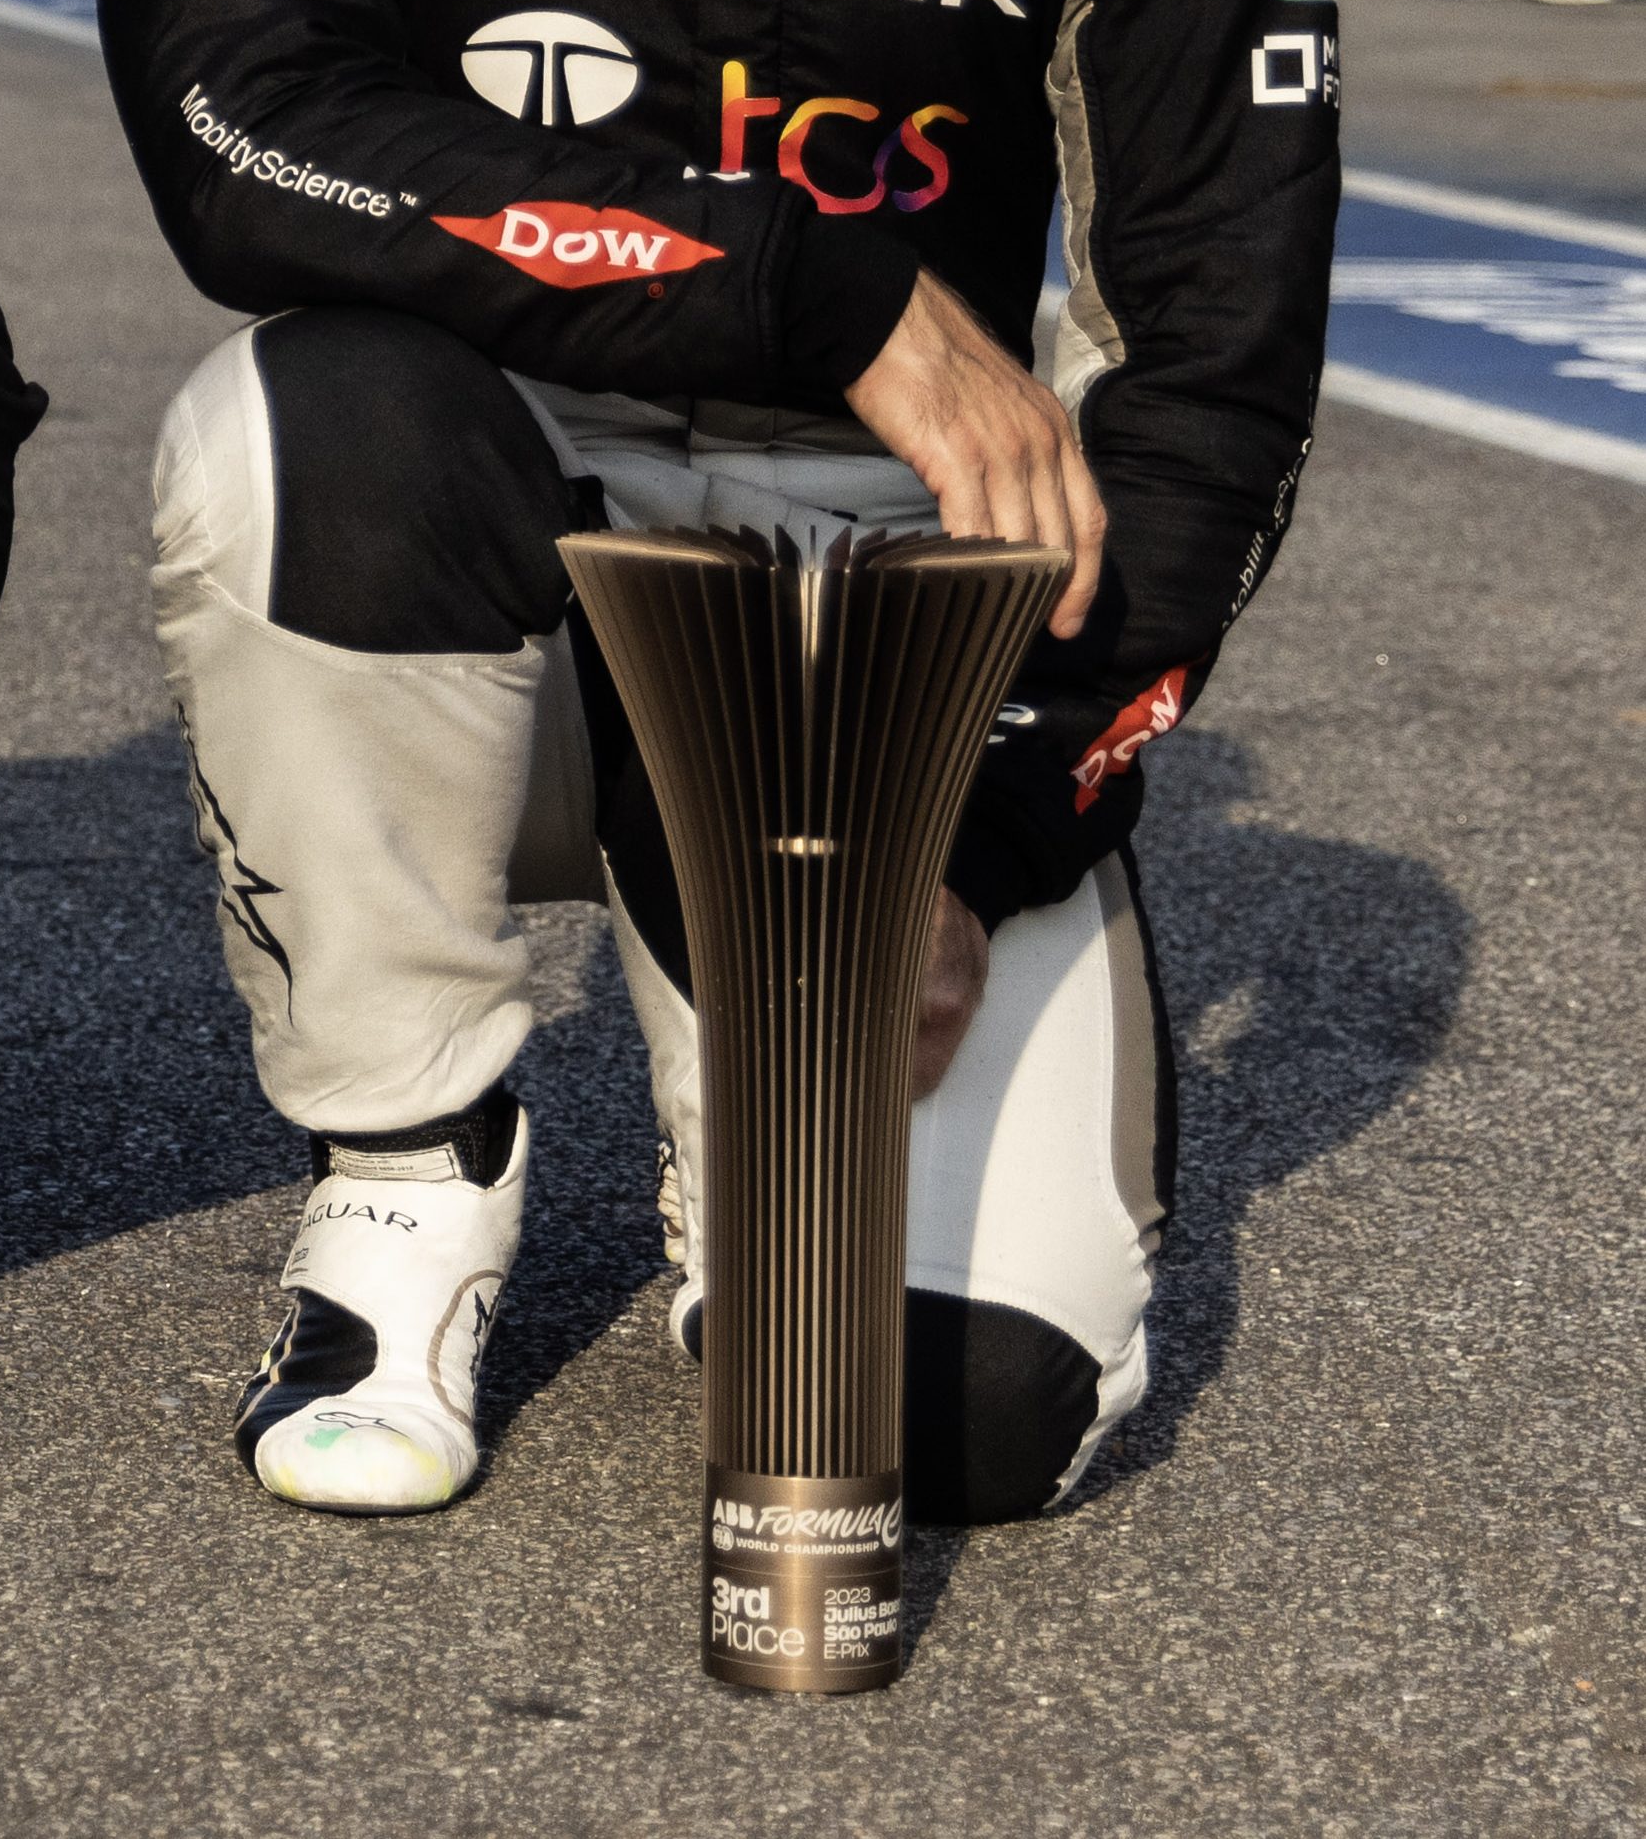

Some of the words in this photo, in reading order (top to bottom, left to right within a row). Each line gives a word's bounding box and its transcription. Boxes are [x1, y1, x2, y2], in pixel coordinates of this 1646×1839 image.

[719, 61, 969, 215] tcs
[713, 1497, 755, 1530] ABB
[755, 1504, 886, 1540] FORMULA
[736, 1536, 780, 1554] WORLD
[783, 1540, 881, 1556] CHAMPIONSHIP
[712, 1576, 771, 1621] 3rd
[824, 1586, 871, 1606] 2023
[824, 1604, 877, 1624] Julius
[712, 1611, 806, 1659] Place
[863, 1618, 898, 1639] Paulo
[824, 1641, 870, 1660] E-Prix
